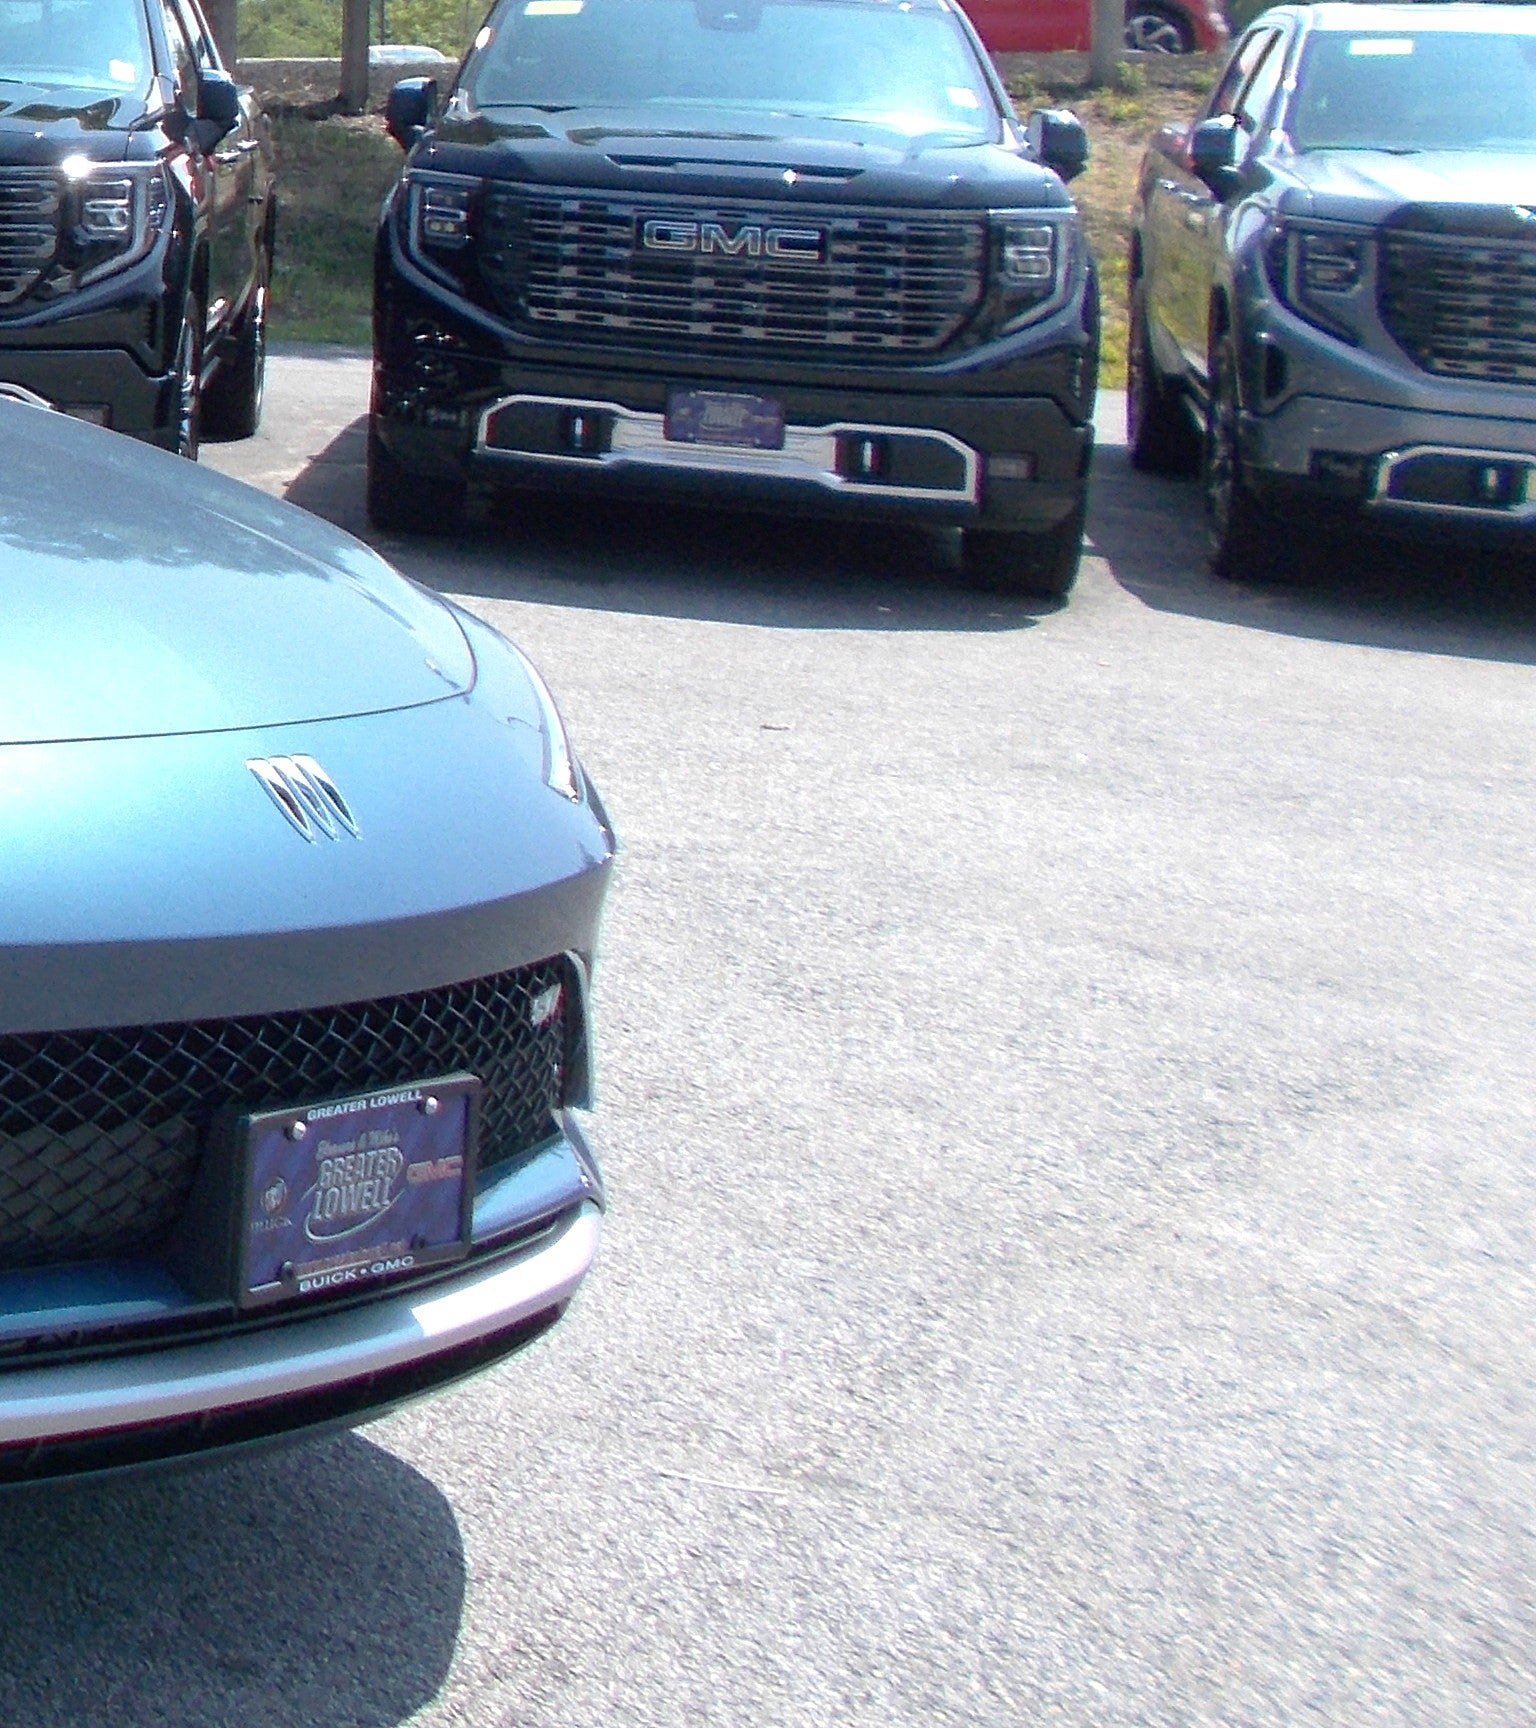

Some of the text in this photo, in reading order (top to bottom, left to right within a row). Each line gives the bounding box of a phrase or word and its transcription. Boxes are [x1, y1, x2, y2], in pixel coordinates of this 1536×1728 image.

[644, 220, 819, 259] GMC
[307, 1089, 423, 1121] GREATER LOWELL
[318, 1147, 400, 1188] GREATER
[312, 1177, 392, 1219] LOWELL
[299, 1268, 357, 1292] BUICK
[370, 1255, 415, 1274] GMC
